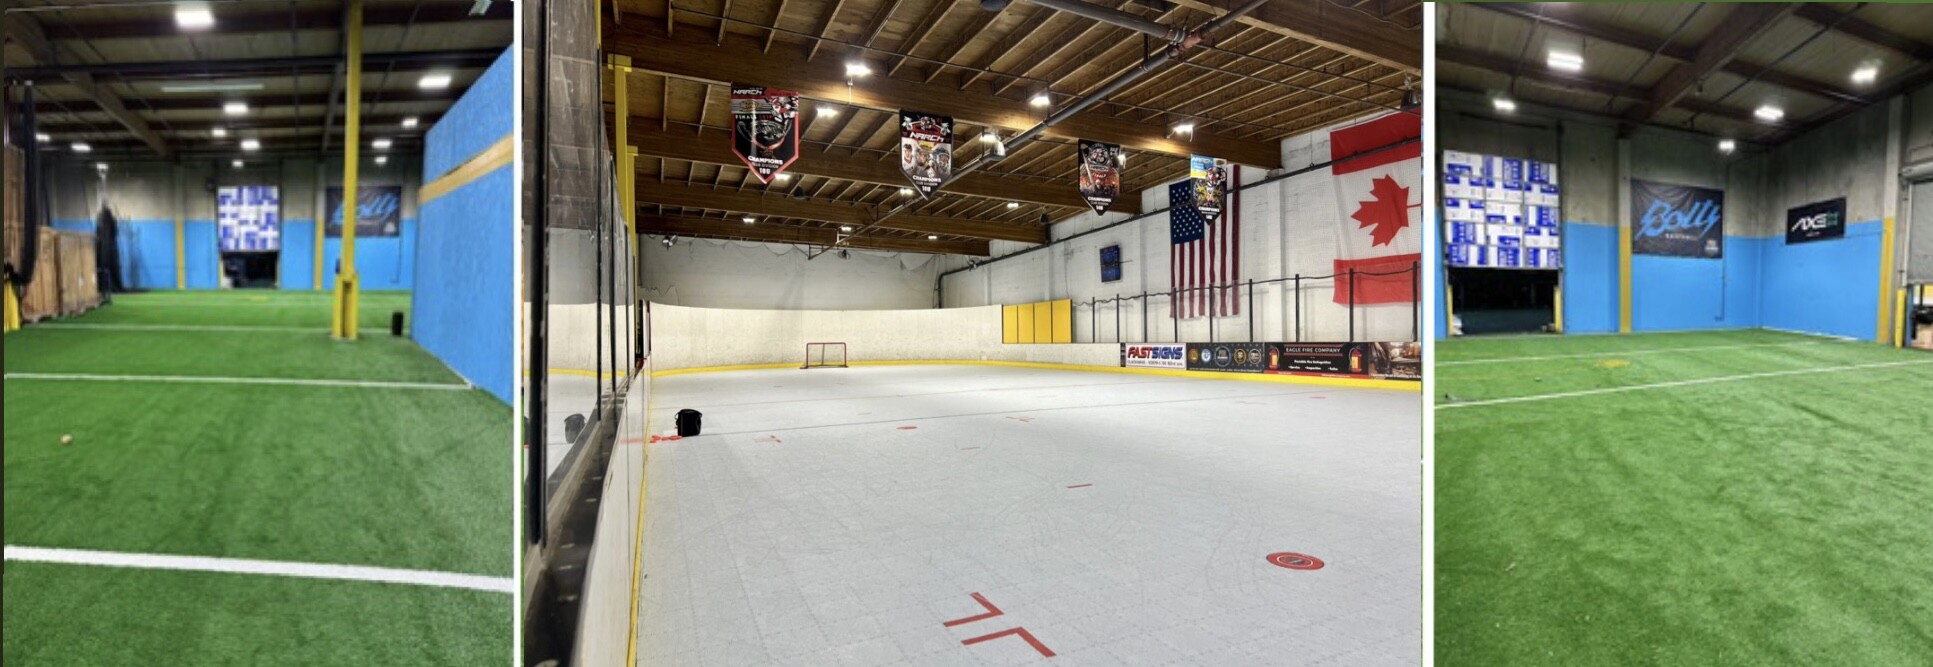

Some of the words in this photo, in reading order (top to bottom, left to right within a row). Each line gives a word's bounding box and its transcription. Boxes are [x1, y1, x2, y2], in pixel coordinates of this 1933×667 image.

[910, 132, 944, 142] NARCH
[748, 156, 783, 165] CHAMPIONS
[912, 175, 942, 183] CHAMPIONS
[1128, 346, 1183, 359] FASTSIGNS
